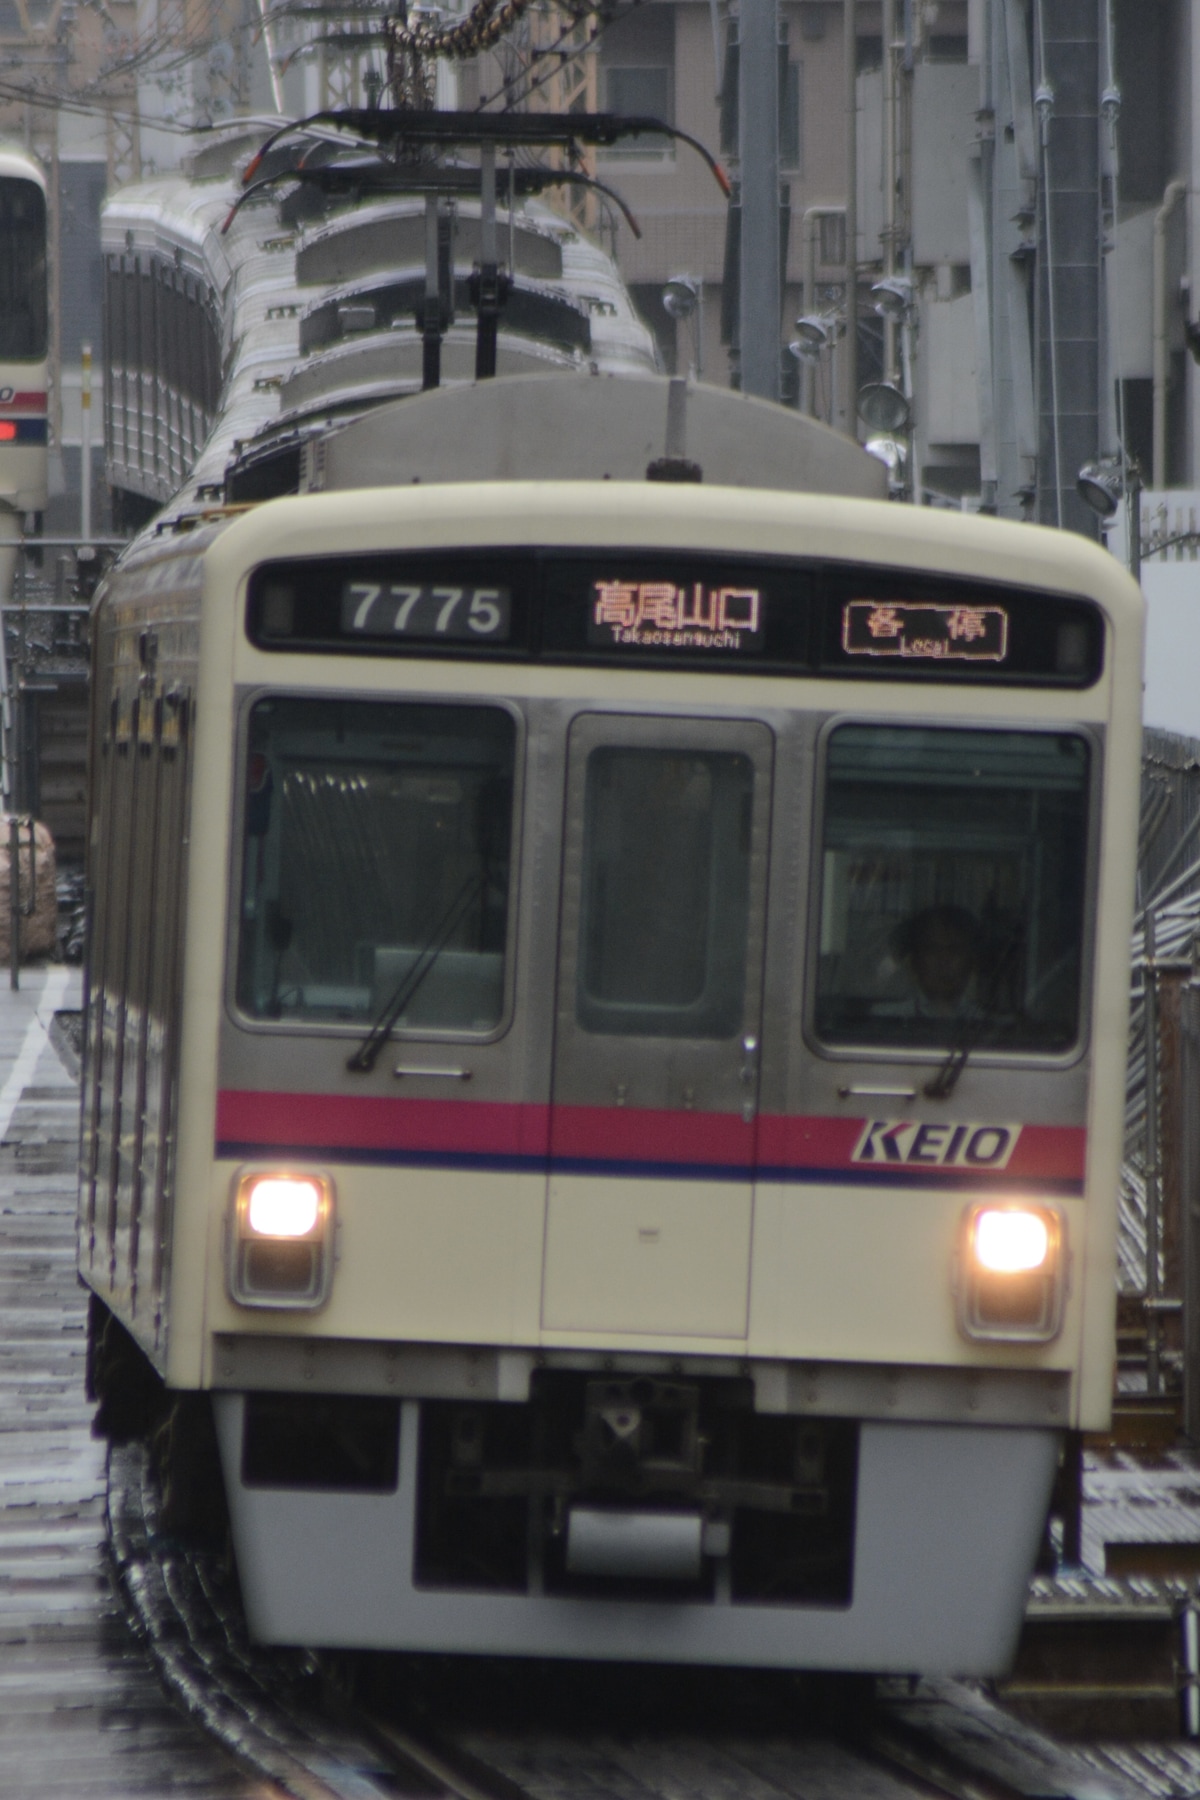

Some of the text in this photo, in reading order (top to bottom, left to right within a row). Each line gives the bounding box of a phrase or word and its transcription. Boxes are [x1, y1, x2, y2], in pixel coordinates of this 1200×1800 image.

[350, 584, 501, 633] 7775
[594, 580, 759, 632] 高尾山口
[901, 635, 949, 655] Local
[858, 1121, 1011, 1165] KEIO
